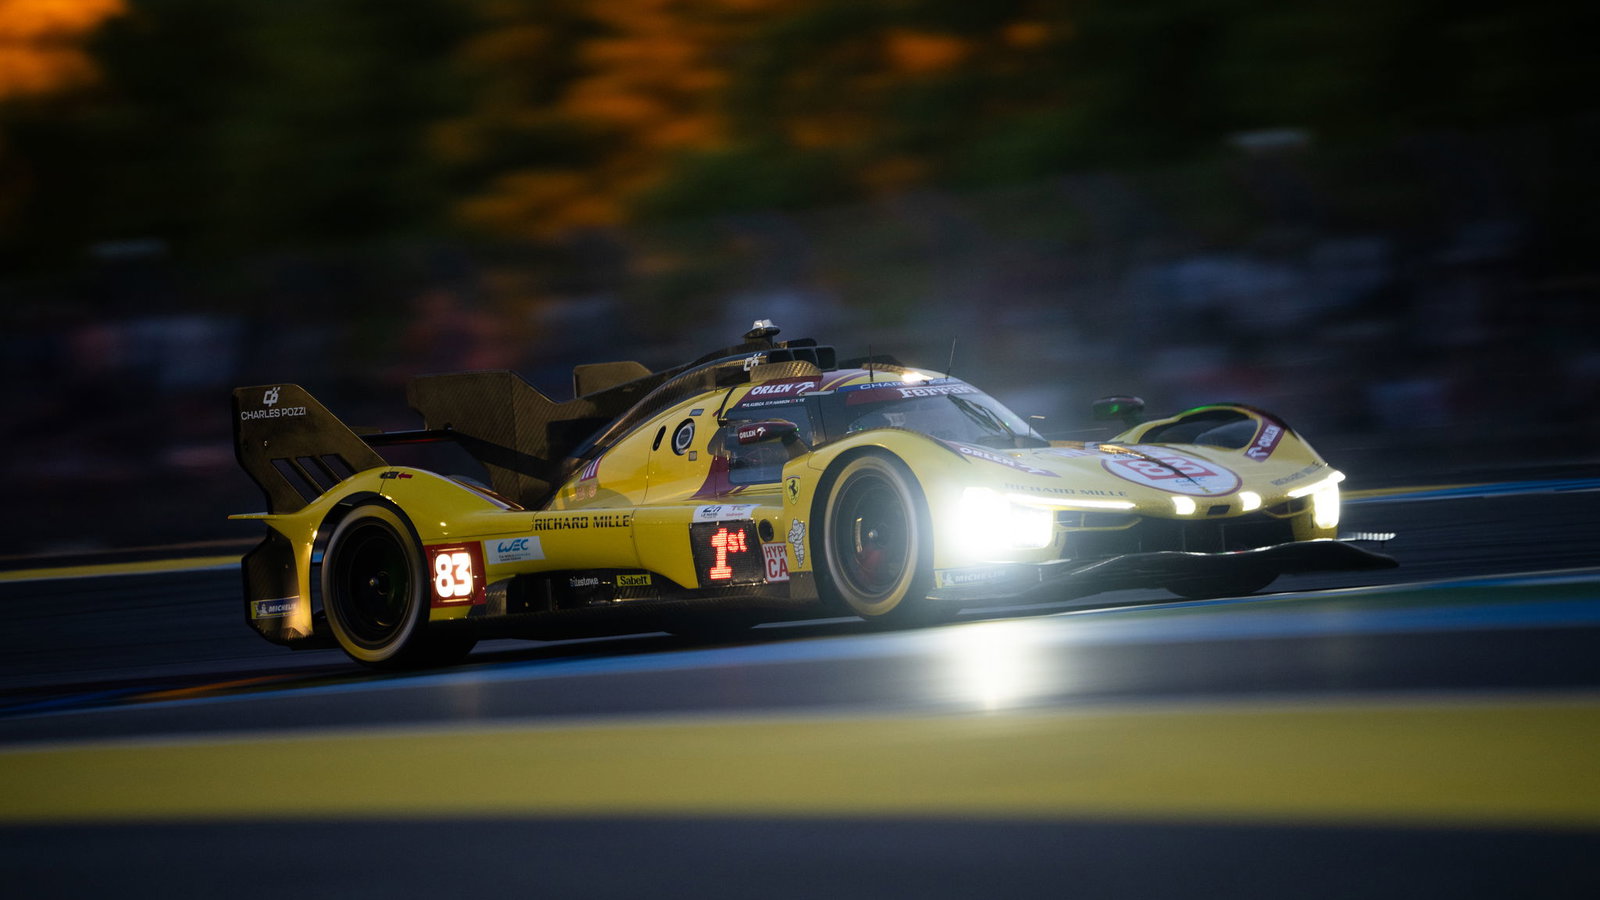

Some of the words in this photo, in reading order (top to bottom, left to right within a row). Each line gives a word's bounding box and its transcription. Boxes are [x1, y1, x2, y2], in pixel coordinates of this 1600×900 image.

[751, 383, 794, 396] ORLEN
[896, 383, 979, 399] Ferrari
[240, 408, 281, 421] CHARLES
[281, 406, 307, 417] POZZI
[739, 429, 756, 440] ORLEN
[959, 447, 1016, 467] ORLEN
[1079, 489, 1129, 497] MILLE
[534, 516, 589, 531] RICHARD
[592, 514, 631, 529] MILLE
[497, 538, 529, 553] WEC
[710, 527, 748, 580] 1st
[434, 552, 473, 598] 83
[620, 575, 648, 585] Sabelt
